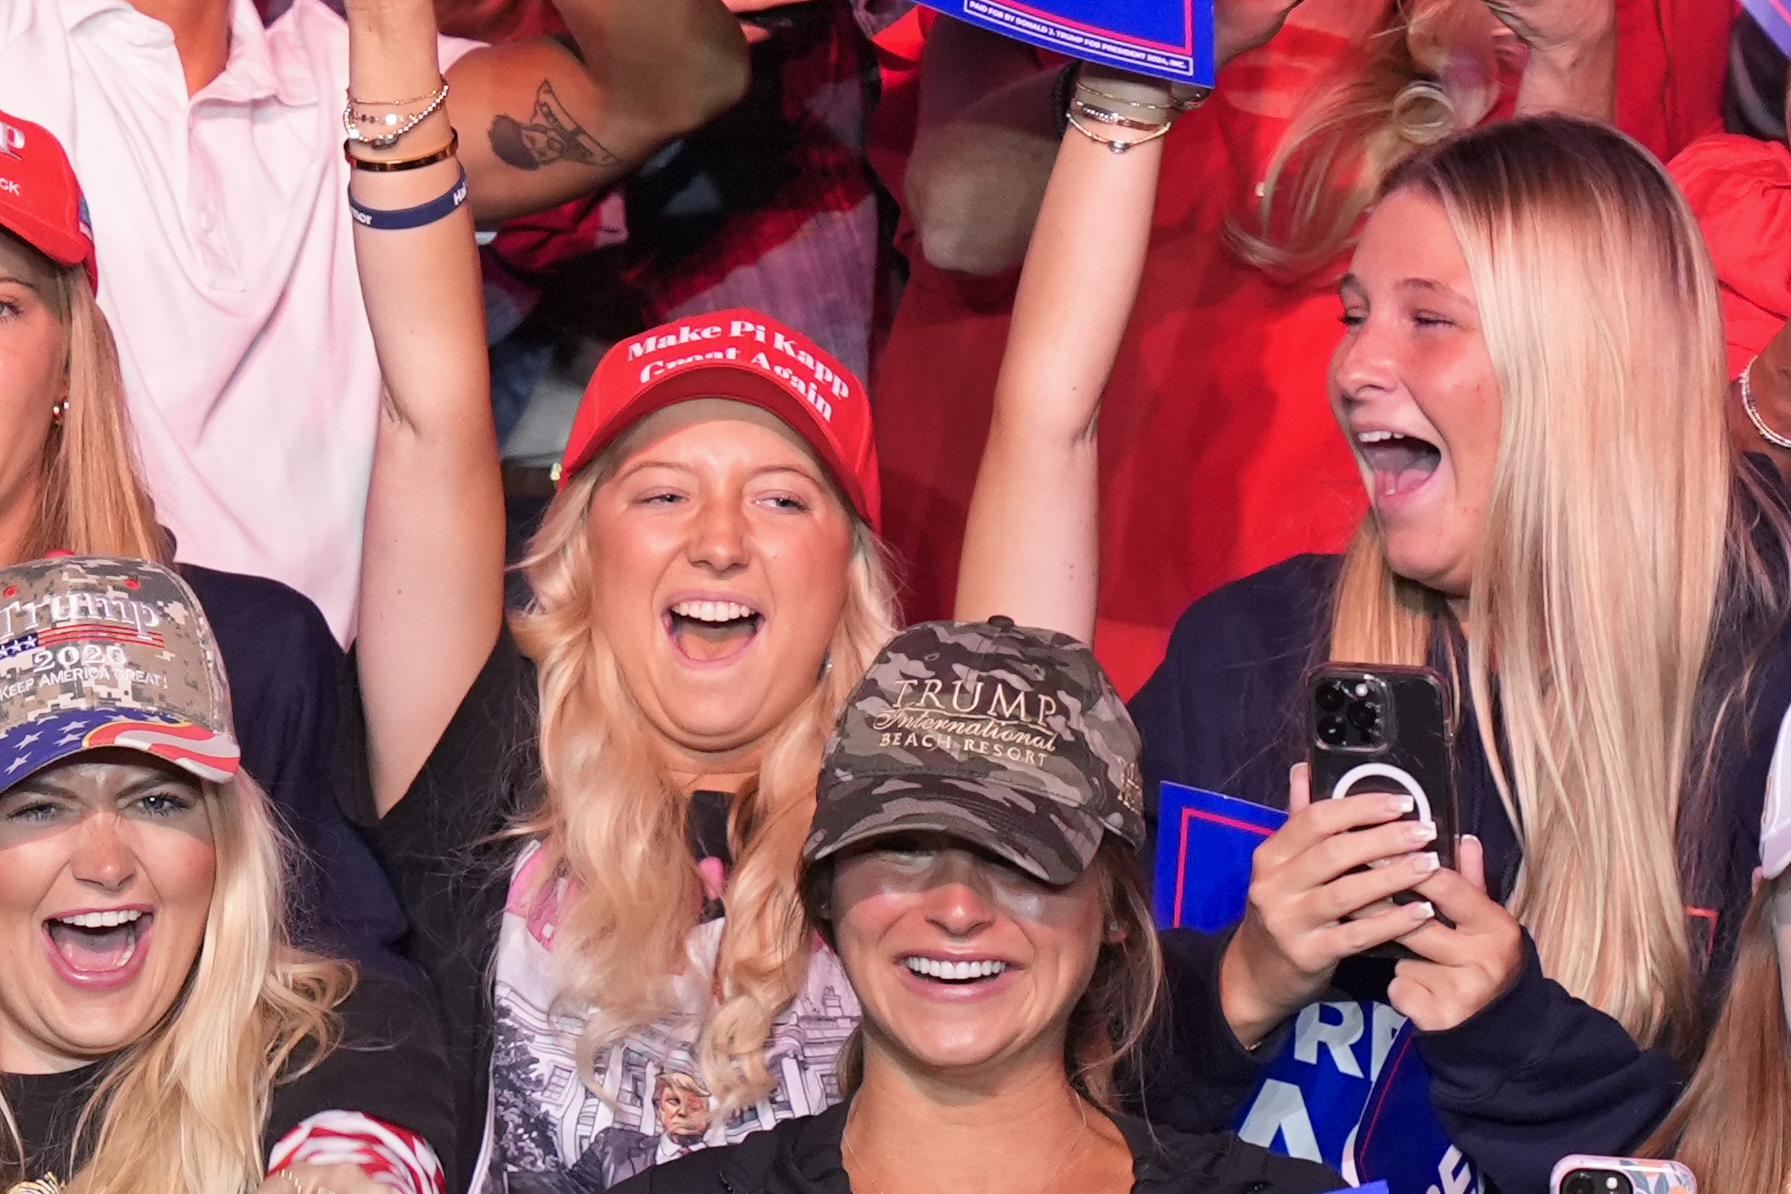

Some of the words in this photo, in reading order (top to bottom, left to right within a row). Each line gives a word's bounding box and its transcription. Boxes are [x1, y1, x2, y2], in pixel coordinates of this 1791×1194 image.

[970, 1, 988, 13] PAID
[988, 8, 1003, 19] FOR
[1015, 17, 1048, 33] DONALD
[1055, 30, 1083, 43] TRUMP
[1084, 39, 1101, 48] FOR
[1102, 43, 1146, 59] PRESIDENT
[627, 325, 722, 361] Make
[728, 320, 767, 343] Pi
[773, 331, 850, 400] Kapp
[33, 643, 128, 674] 2020
[39, 668, 110, 687] AMERICA
[114, 668, 168, 690] GREAT!
[891, 678, 1057, 727] TRUMP
[872, 708, 1059, 752] International
[879, 733, 952, 752] BEACH
[964, 739, 1049, 767] RESORT
